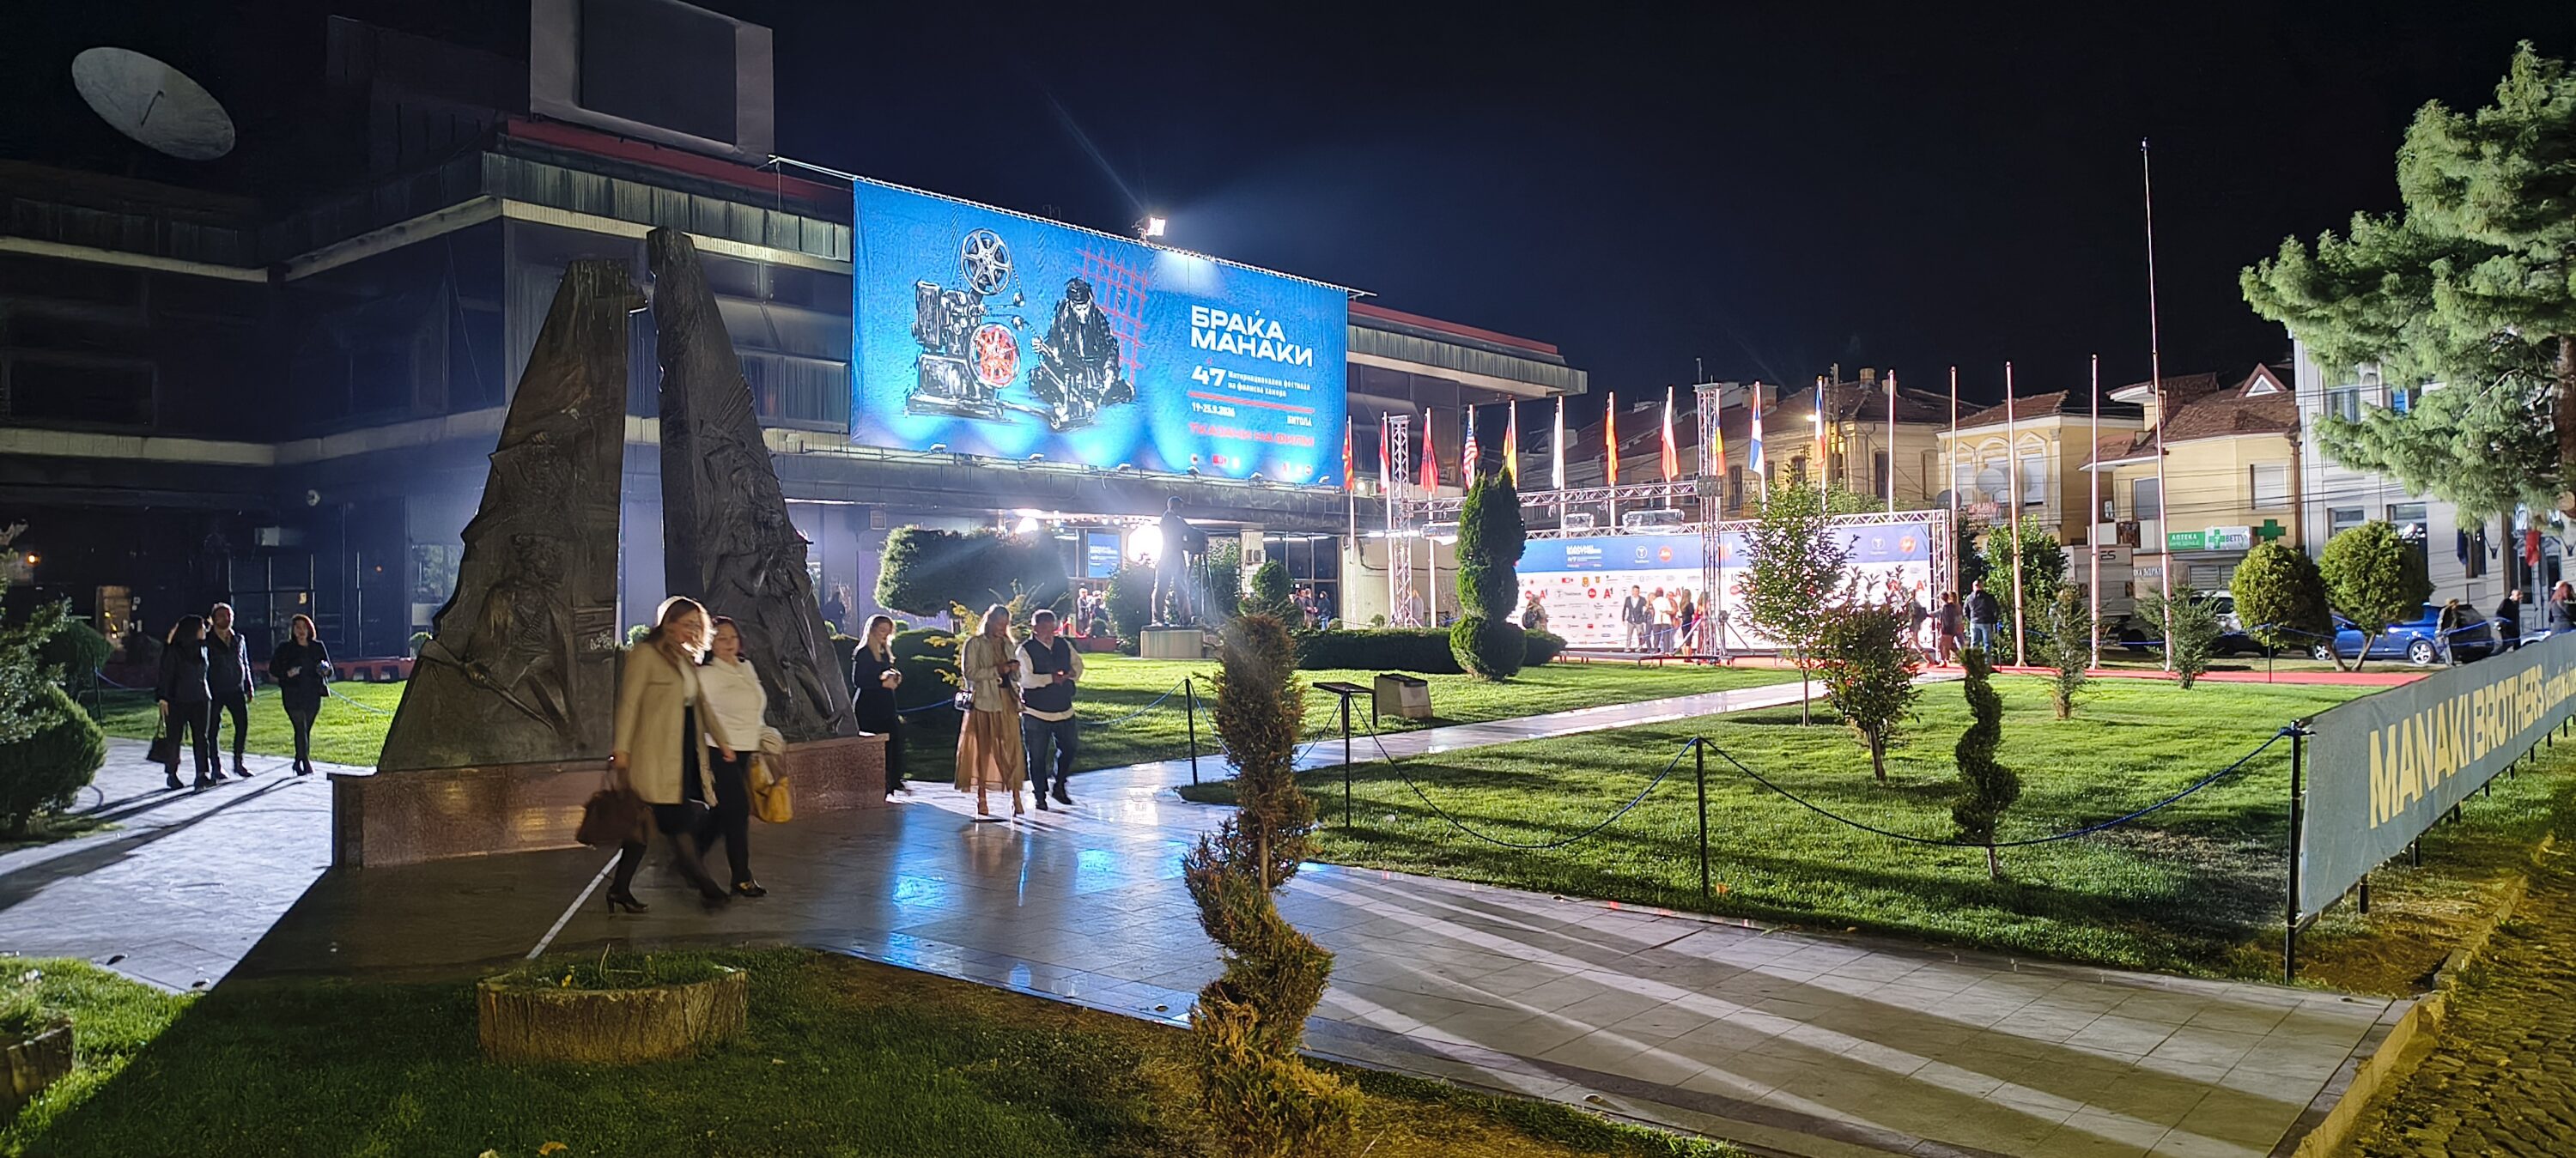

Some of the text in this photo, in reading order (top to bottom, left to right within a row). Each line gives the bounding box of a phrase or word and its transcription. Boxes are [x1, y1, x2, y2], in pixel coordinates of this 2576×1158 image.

[1191, 305, 1286, 343] БРАЌА
[1190, 326, 1313, 367] МАНАКИ
[1191, 365, 1226, 386] 47
[2369, 694, 2470, 829] MANAKI
[2472, 664, 2543, 762] BROTHERS
